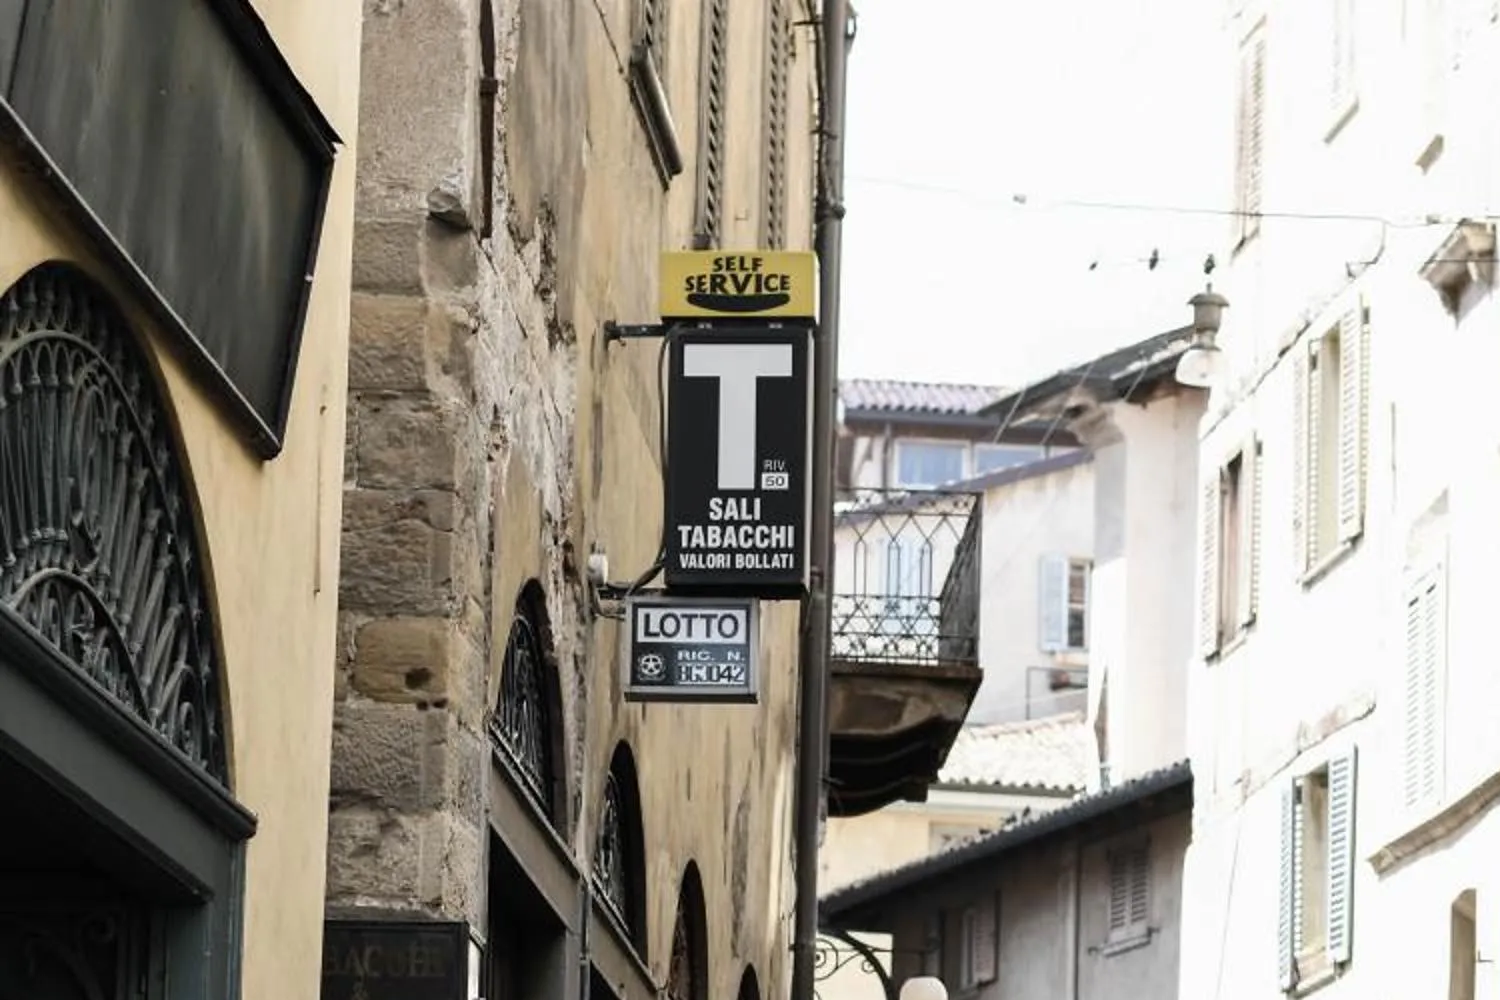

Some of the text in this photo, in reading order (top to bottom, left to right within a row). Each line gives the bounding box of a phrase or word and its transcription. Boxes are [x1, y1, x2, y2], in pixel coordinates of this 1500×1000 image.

[713, 256, 764, 272] SELF
[685, 273, 791, 294] SERVICE
[684, 344, 793, 490] T
[765, 475, 785, 487] 50
[709, 497, 761, 520] SALI
[677, 525, 795, 549] TABACCHI
[680, 553, 794, 569] VALORI BOLLATI
[644, 612, 739, 638] LOTTO
[727, 650, 745, 661] N.
